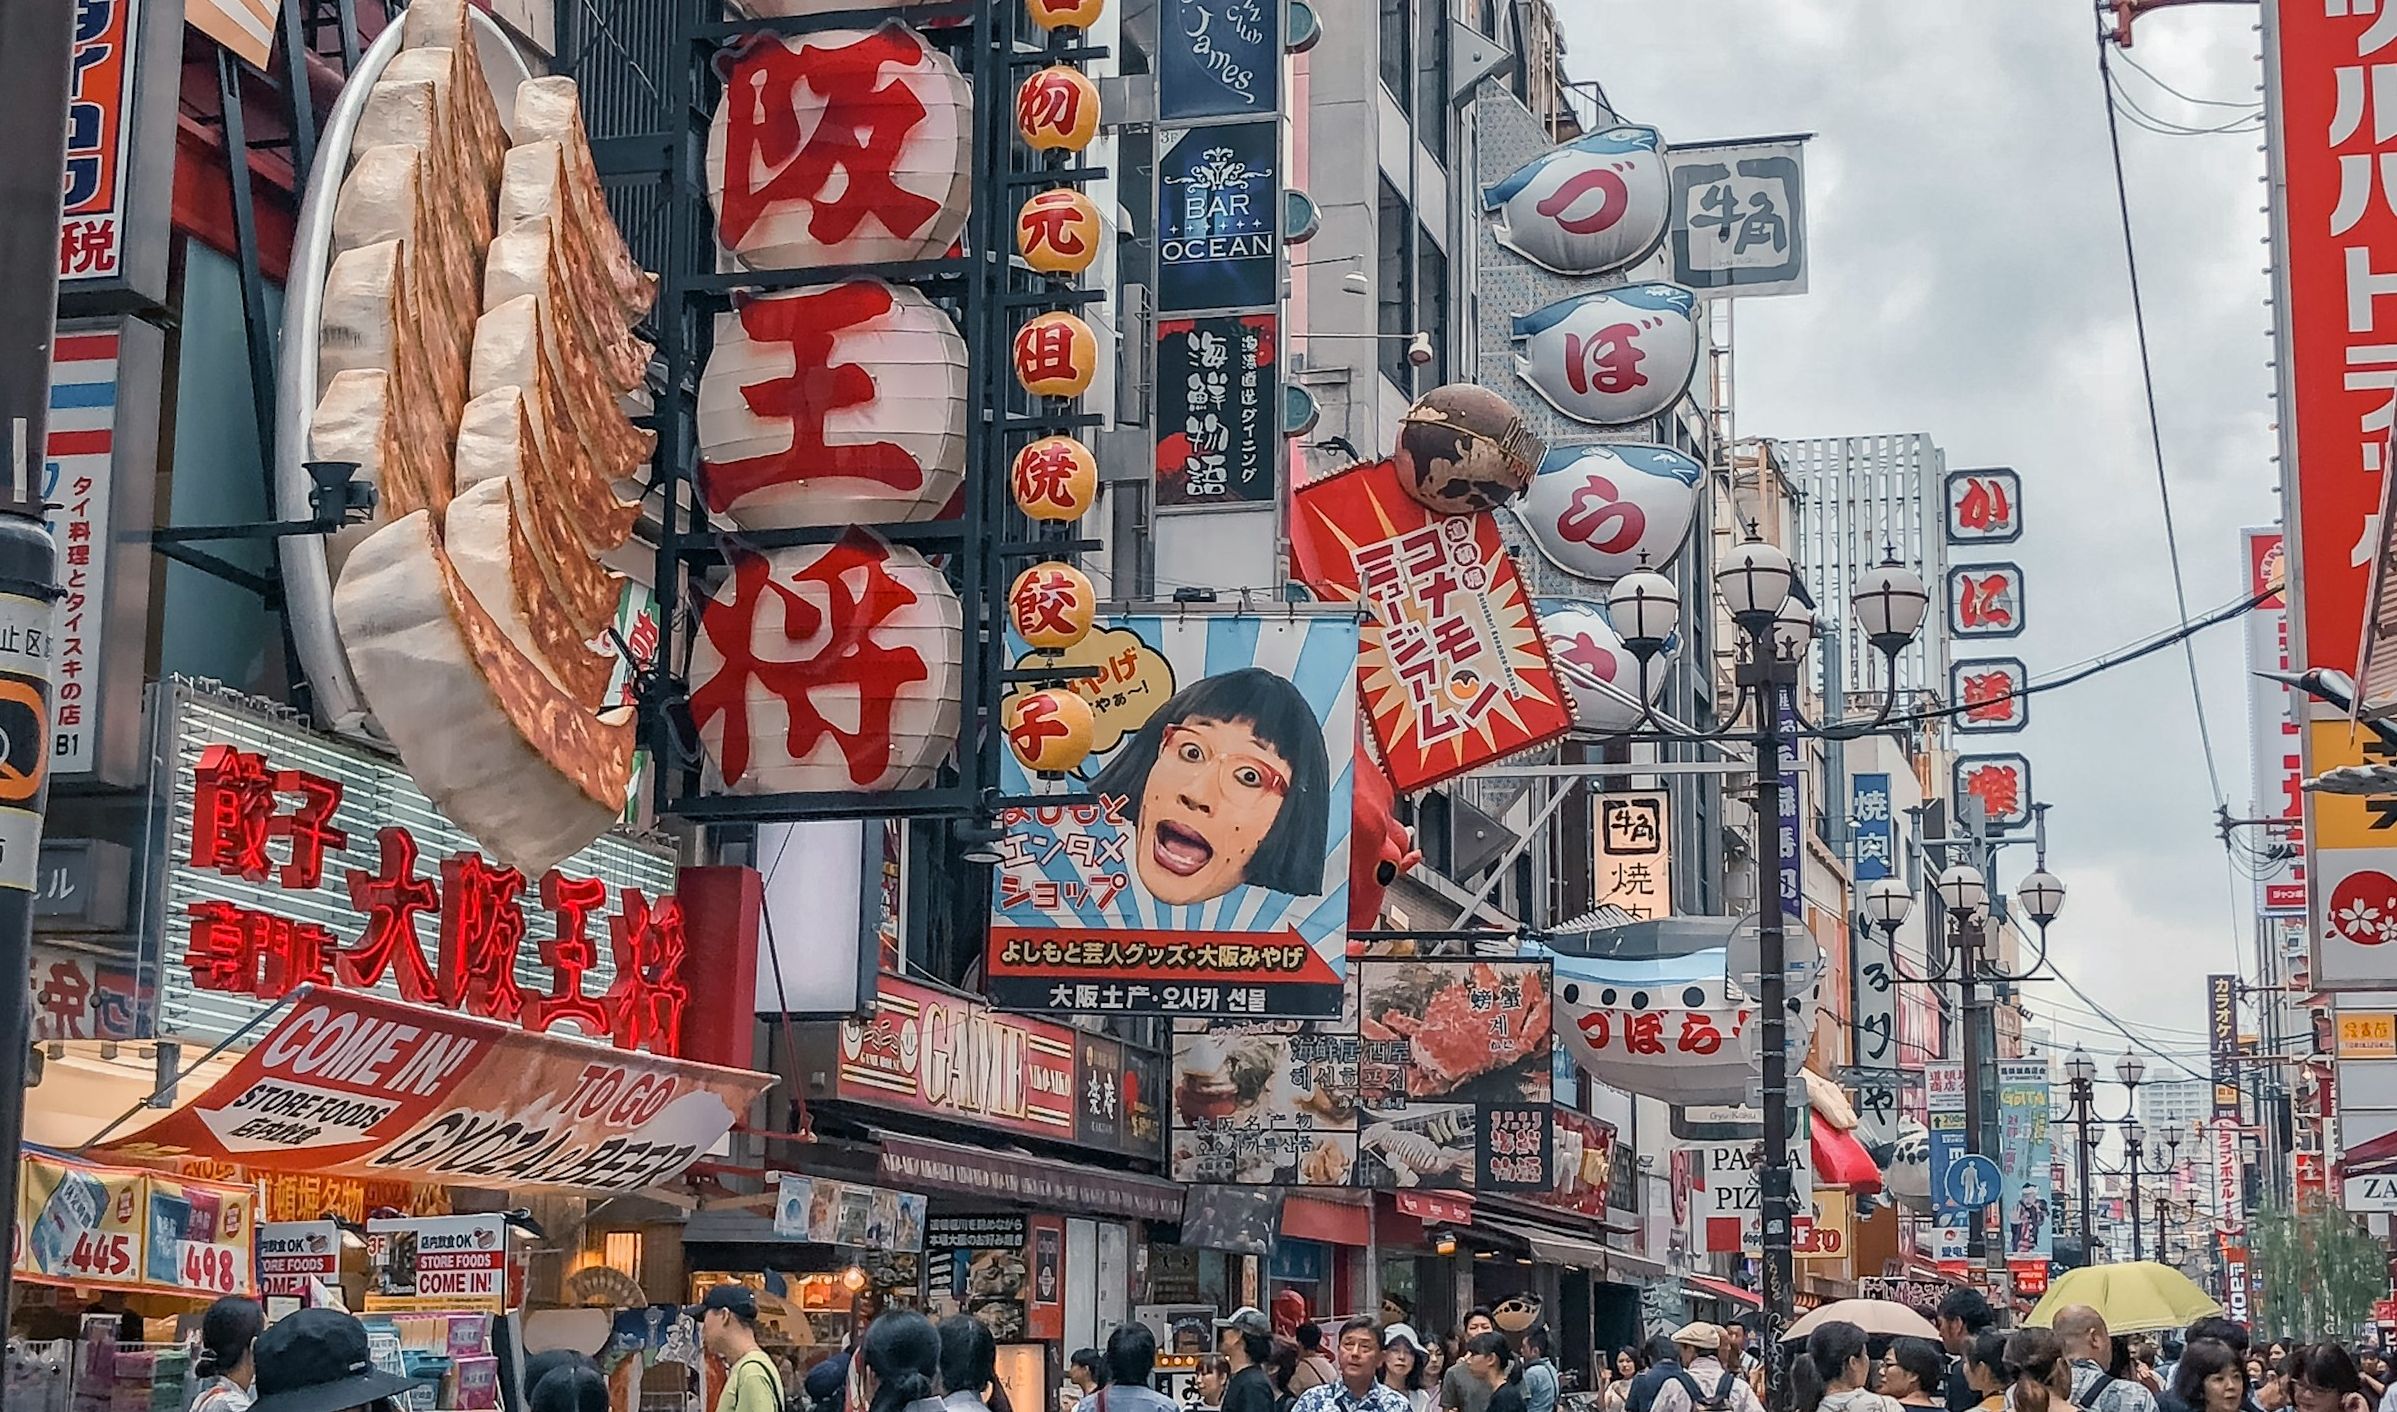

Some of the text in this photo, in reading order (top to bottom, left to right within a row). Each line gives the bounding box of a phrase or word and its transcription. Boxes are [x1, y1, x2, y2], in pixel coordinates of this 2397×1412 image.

[1184, 5, 1255, 92] James
[1160, 131, 1179, 144] 3F
[1186, 194, 1251, 220] BAR
[1689, 184, 1787, 254] 牛角
[1161, 234, 1273, 263] OCEAN
[57, 476, 93, 727] タイ料理とタイスキの店
[1355, 543, 1461, 742] ミュージアム
[1066, 646, 1140, 696] やげ
[55, 733, 79, 756] B1
[190, 743, 347, 890] 餃子
[1611, 809, 1655, 843] 牛角
[1854, 790, 1890, 868] 焼肉
[1003, 832, 1130, 868] エンタメ
[1000, 872, 1129, 911] ショップ
[336, 825, 690, 1057] 大阪王将
[1226, 986, 1267, 1013] 선물
[2214, 977, 2232, 1038] カラオケ
[263, 1005, 479, 1097] COME IN!
[1577, 1009, 1751, 1056] づぼら
[920, 1001, 1028, 1121] GAME
[232, 1083, 391, 1130] STORE FOODS
[559, 1064, 677, 1126] TO GO
[1712, 1148, 1806, 1171] PAA
[71, 1231, 131, 1276] 445
[185, 1244, 235, 1293] 498
[287, 1257, 325, 1272] FOODS
[420, 1252, 492, 1269] STORE FOODS
[419, 1274, 466, 1295] COME
[469, 1272, 492, 1293] IN!
